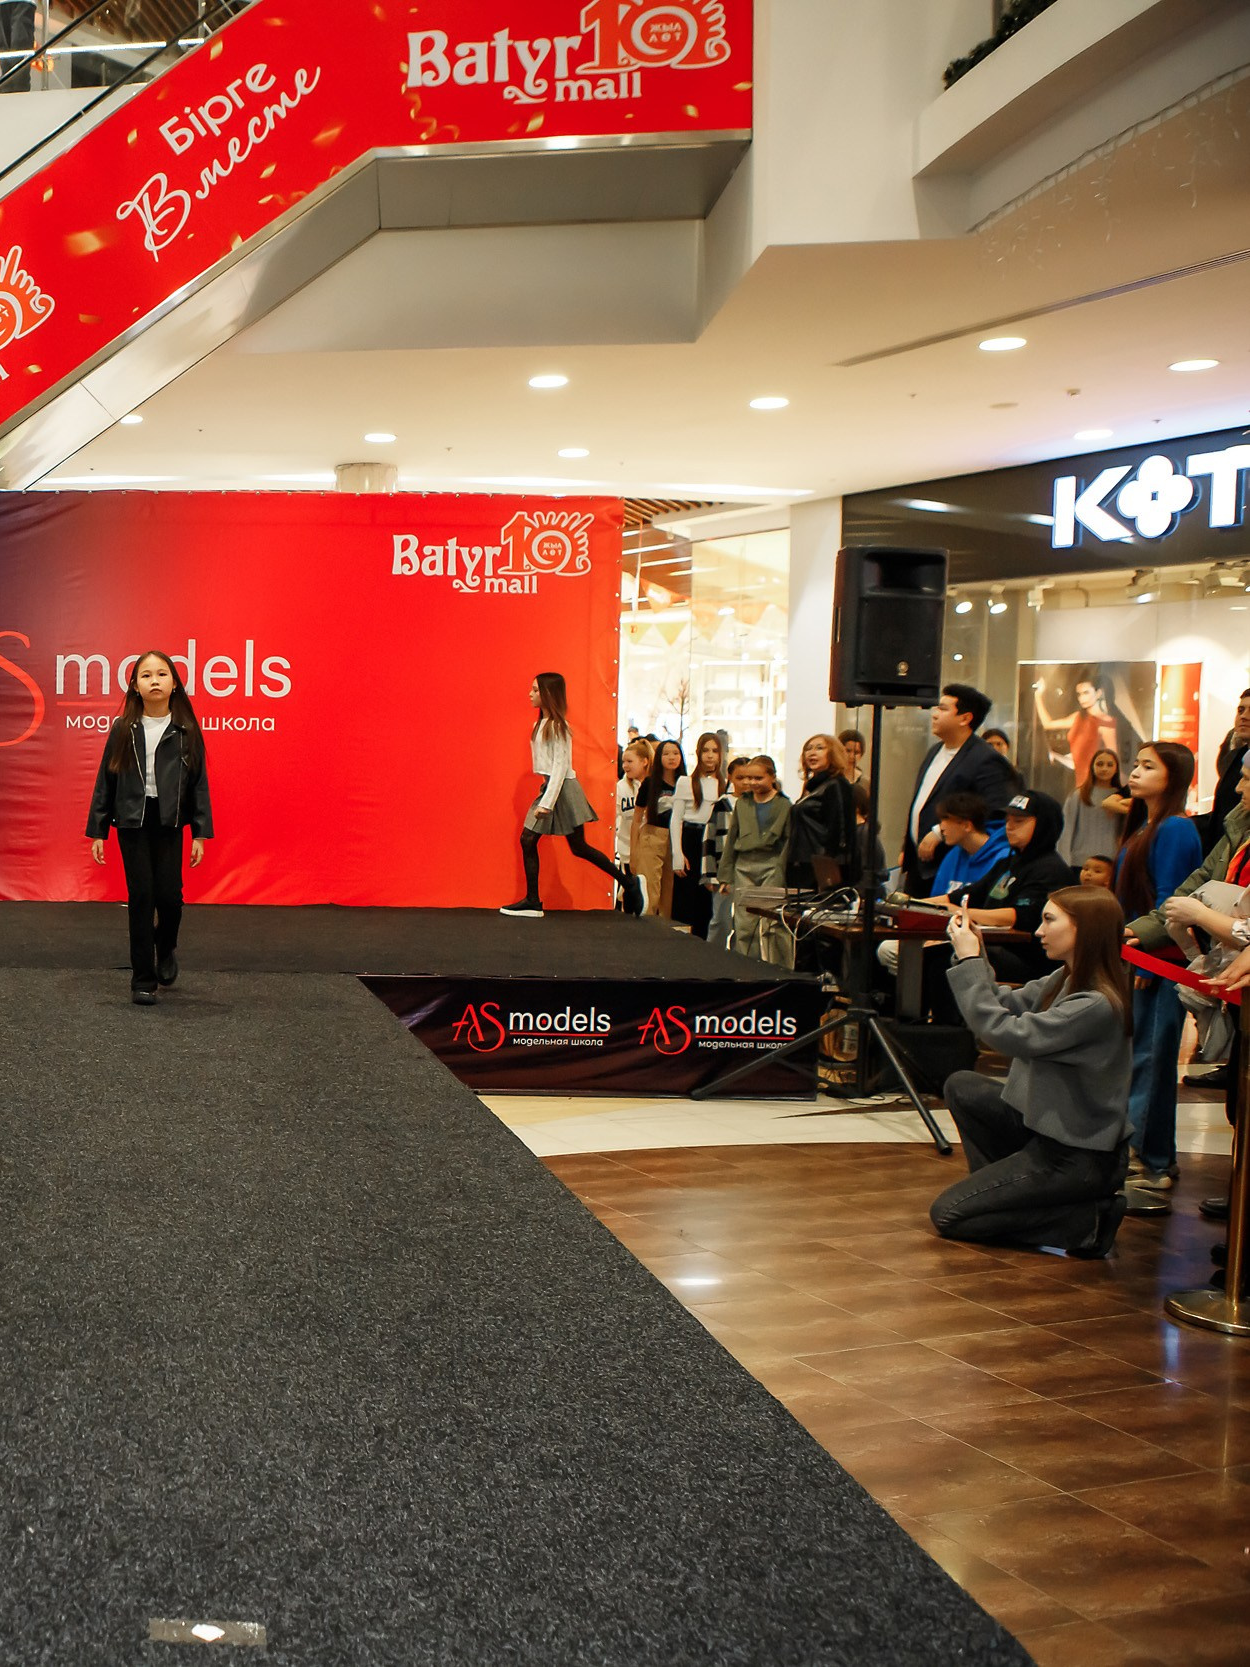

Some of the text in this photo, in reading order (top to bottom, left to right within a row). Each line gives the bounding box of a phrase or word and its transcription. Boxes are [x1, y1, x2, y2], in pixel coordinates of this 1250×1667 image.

[406, 28, 582, 104] Batyr
[554, 72, 642, 102] mall
[159, 63, 276, 156] Бірге
[116, 66, 321, 262] Вместе
[1052, 444, 1250, 549] KOT
[392, 534, 502, 593] Batyr
[484, 575, 538, 594] mall
[66, 715, 275, 732] мод школа
[452, 1001, 611, 1053] AS models
[513, 1037, 604, 1047] модельная школа
[638, 1005, 797, 1055] AS models
[698, 1040, 755, 1050] модельная
